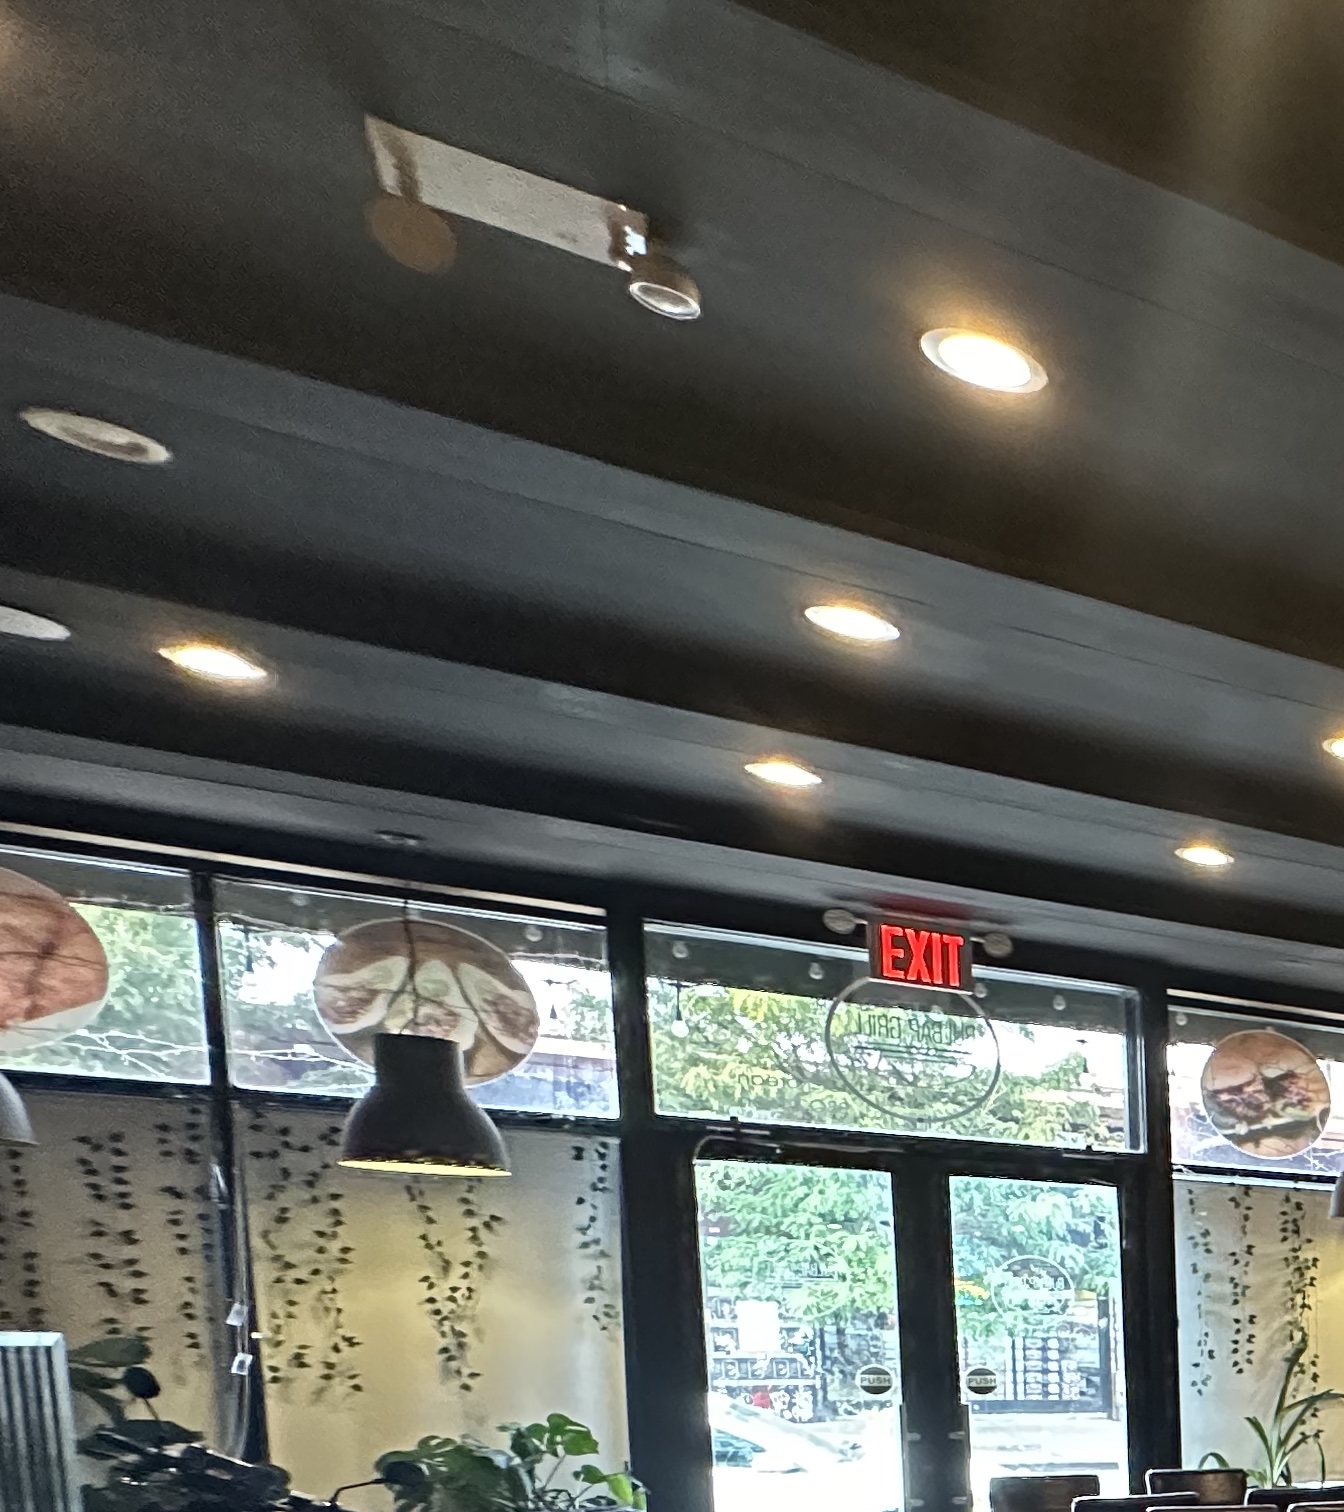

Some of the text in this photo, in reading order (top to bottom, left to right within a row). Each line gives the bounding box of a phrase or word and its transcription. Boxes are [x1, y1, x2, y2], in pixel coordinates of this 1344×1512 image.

[881, 924, 965, 987] EXIT
[860, 1376, 892, 1385] PUSH
[967, 1377, 997, 1385] PUSH
